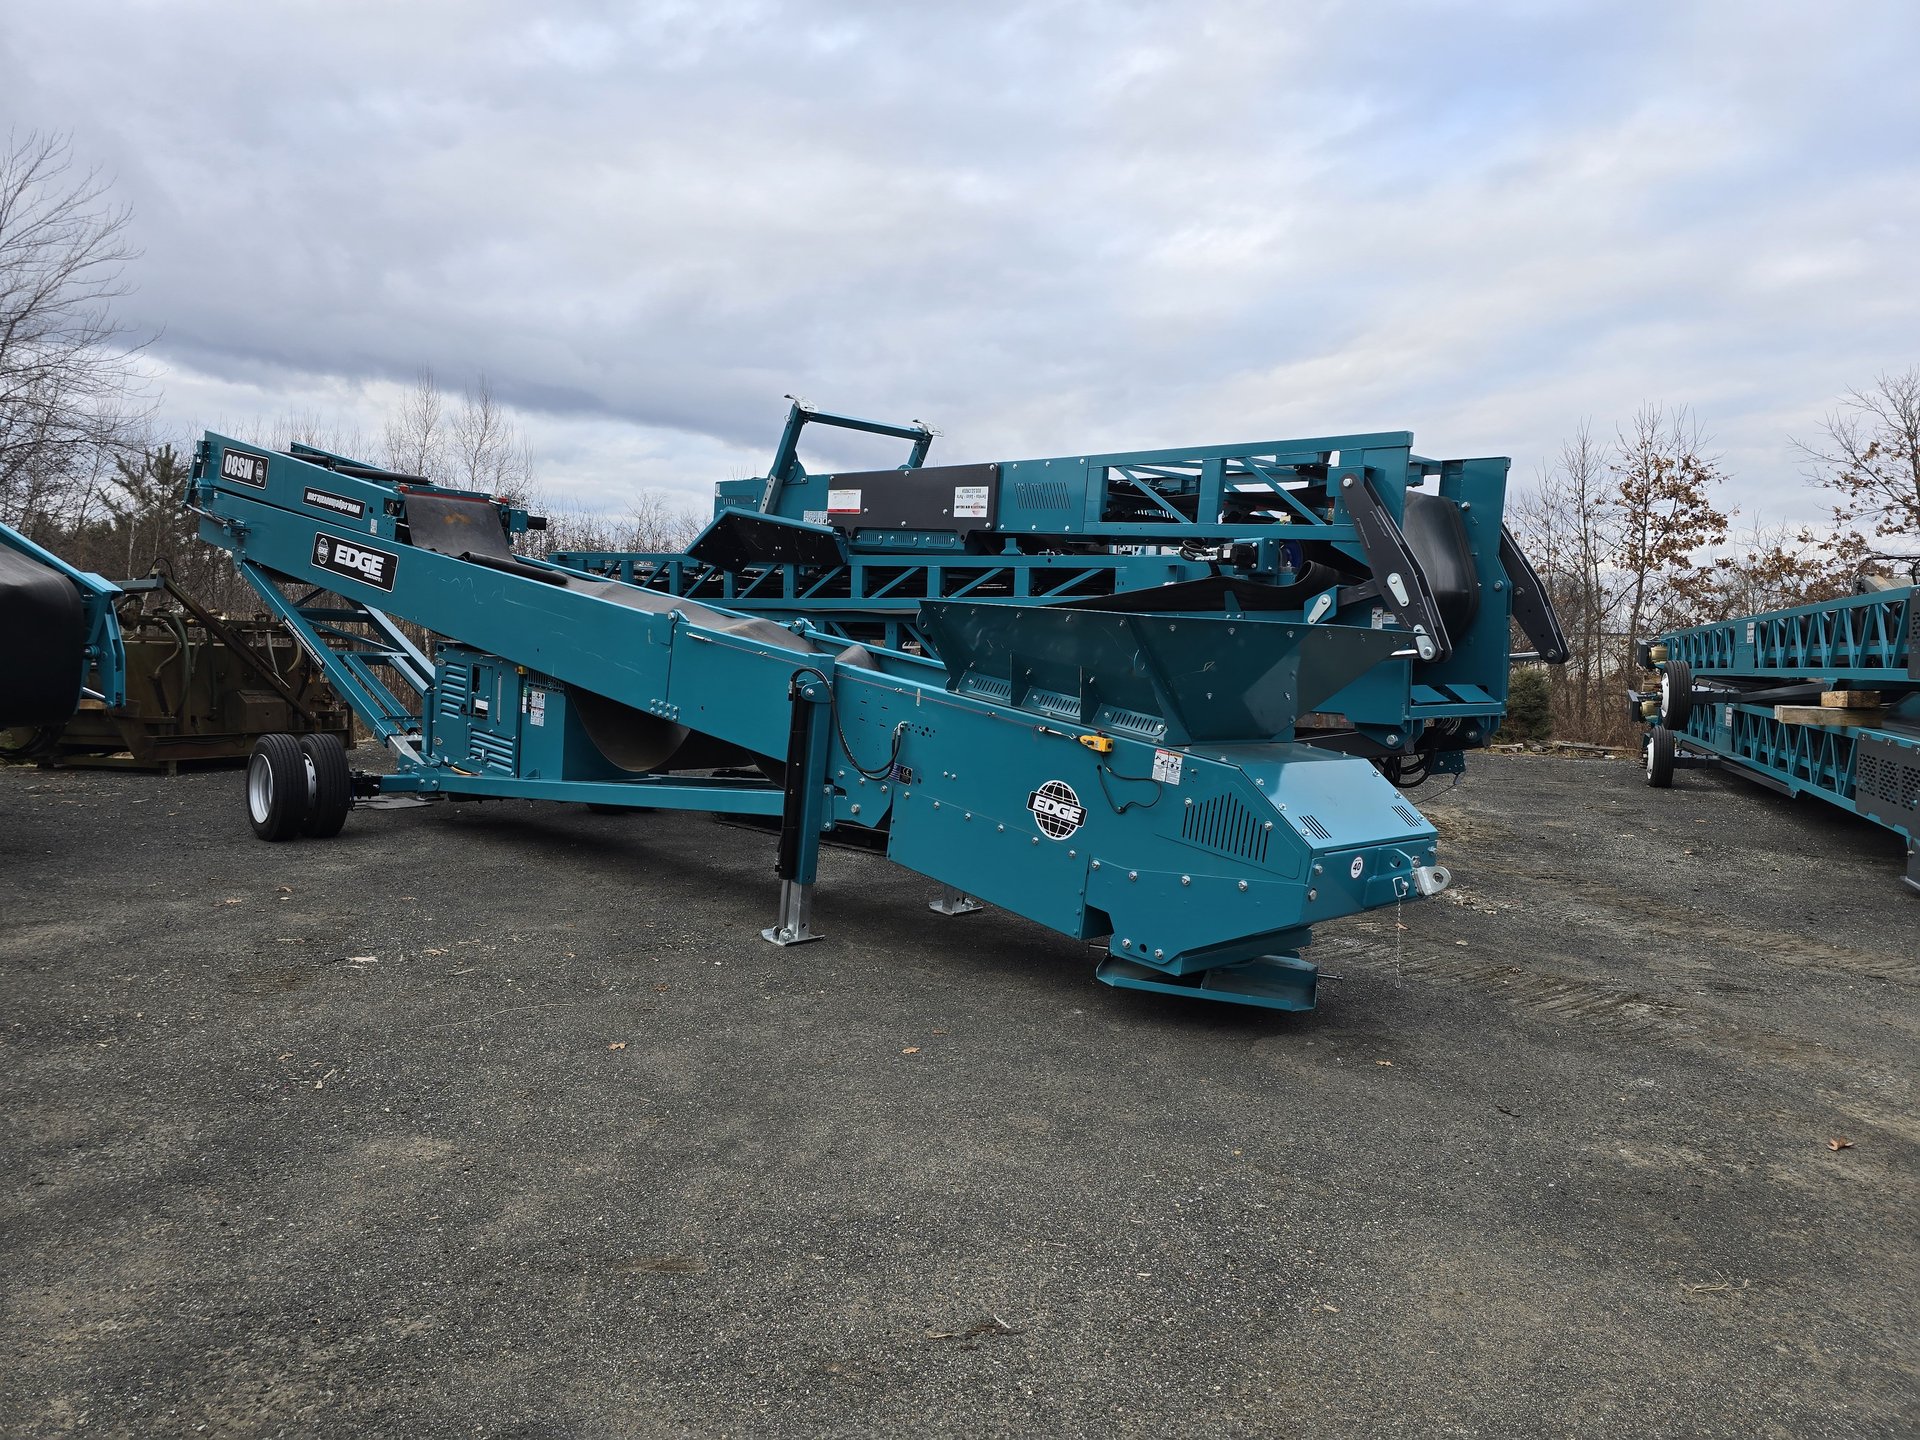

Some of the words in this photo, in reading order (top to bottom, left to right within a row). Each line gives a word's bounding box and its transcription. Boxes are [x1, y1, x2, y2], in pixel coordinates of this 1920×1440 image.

[224, 454, 254, 480] MS80
[334, 544, 385, 577] EDGE
[1032, 795, 1082, 824] EDGE
[1352, 862, 1362, 870] 40
